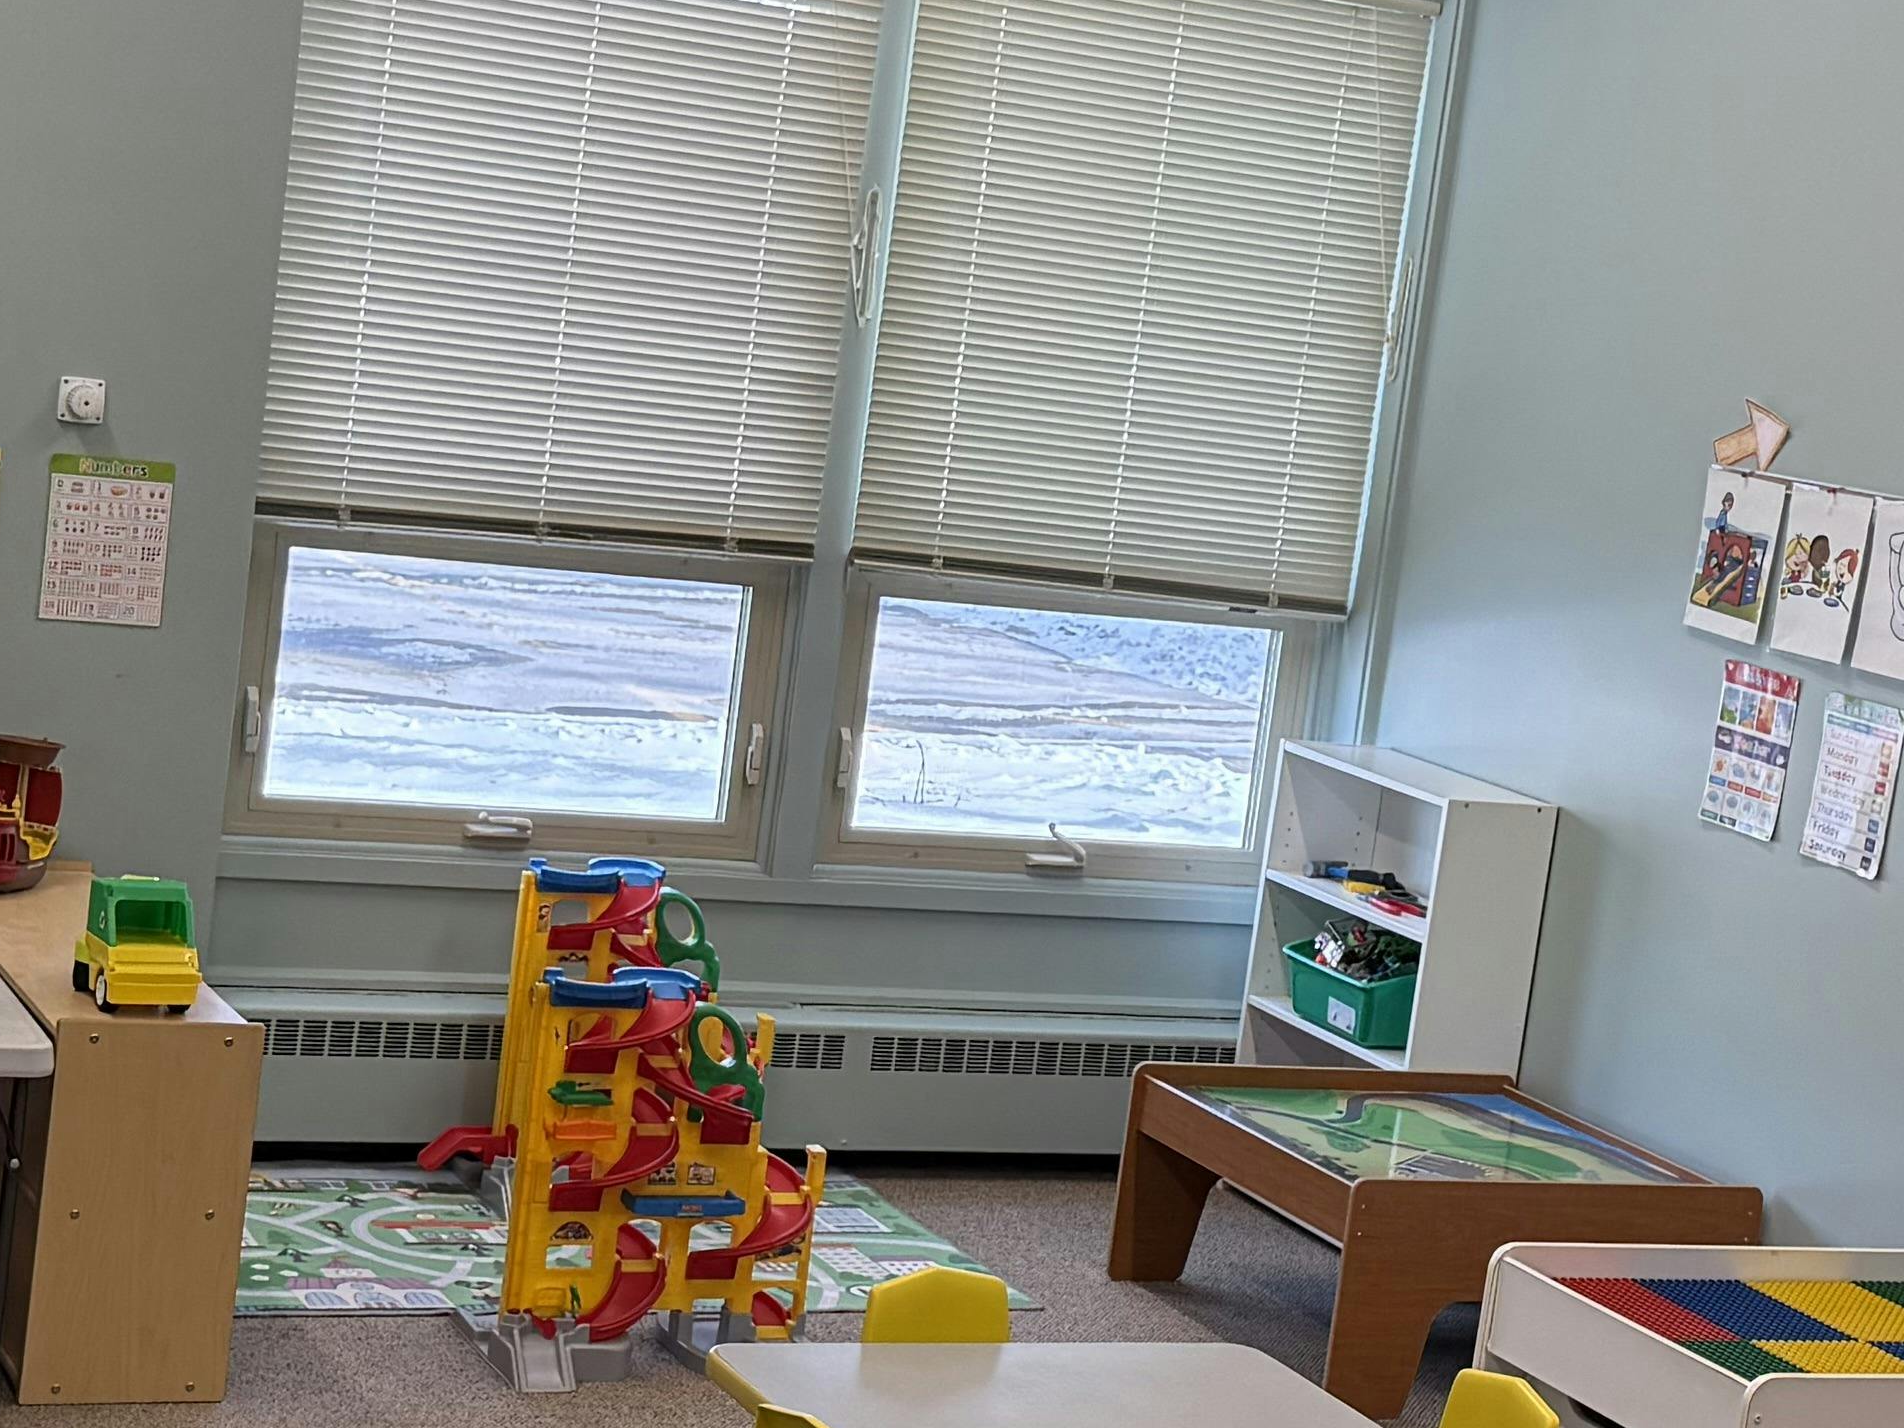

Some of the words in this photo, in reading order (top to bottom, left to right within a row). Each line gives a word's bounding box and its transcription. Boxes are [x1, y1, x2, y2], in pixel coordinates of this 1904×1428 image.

[79, 457, 149, 478] Numbers
[1827, 748, 1858, 766] Monday
[1824, 766, 1856, 785] Tuesday
[1817, 803, 1853, 822] Thursday
[1813, 821, 1840, 839] Friday
